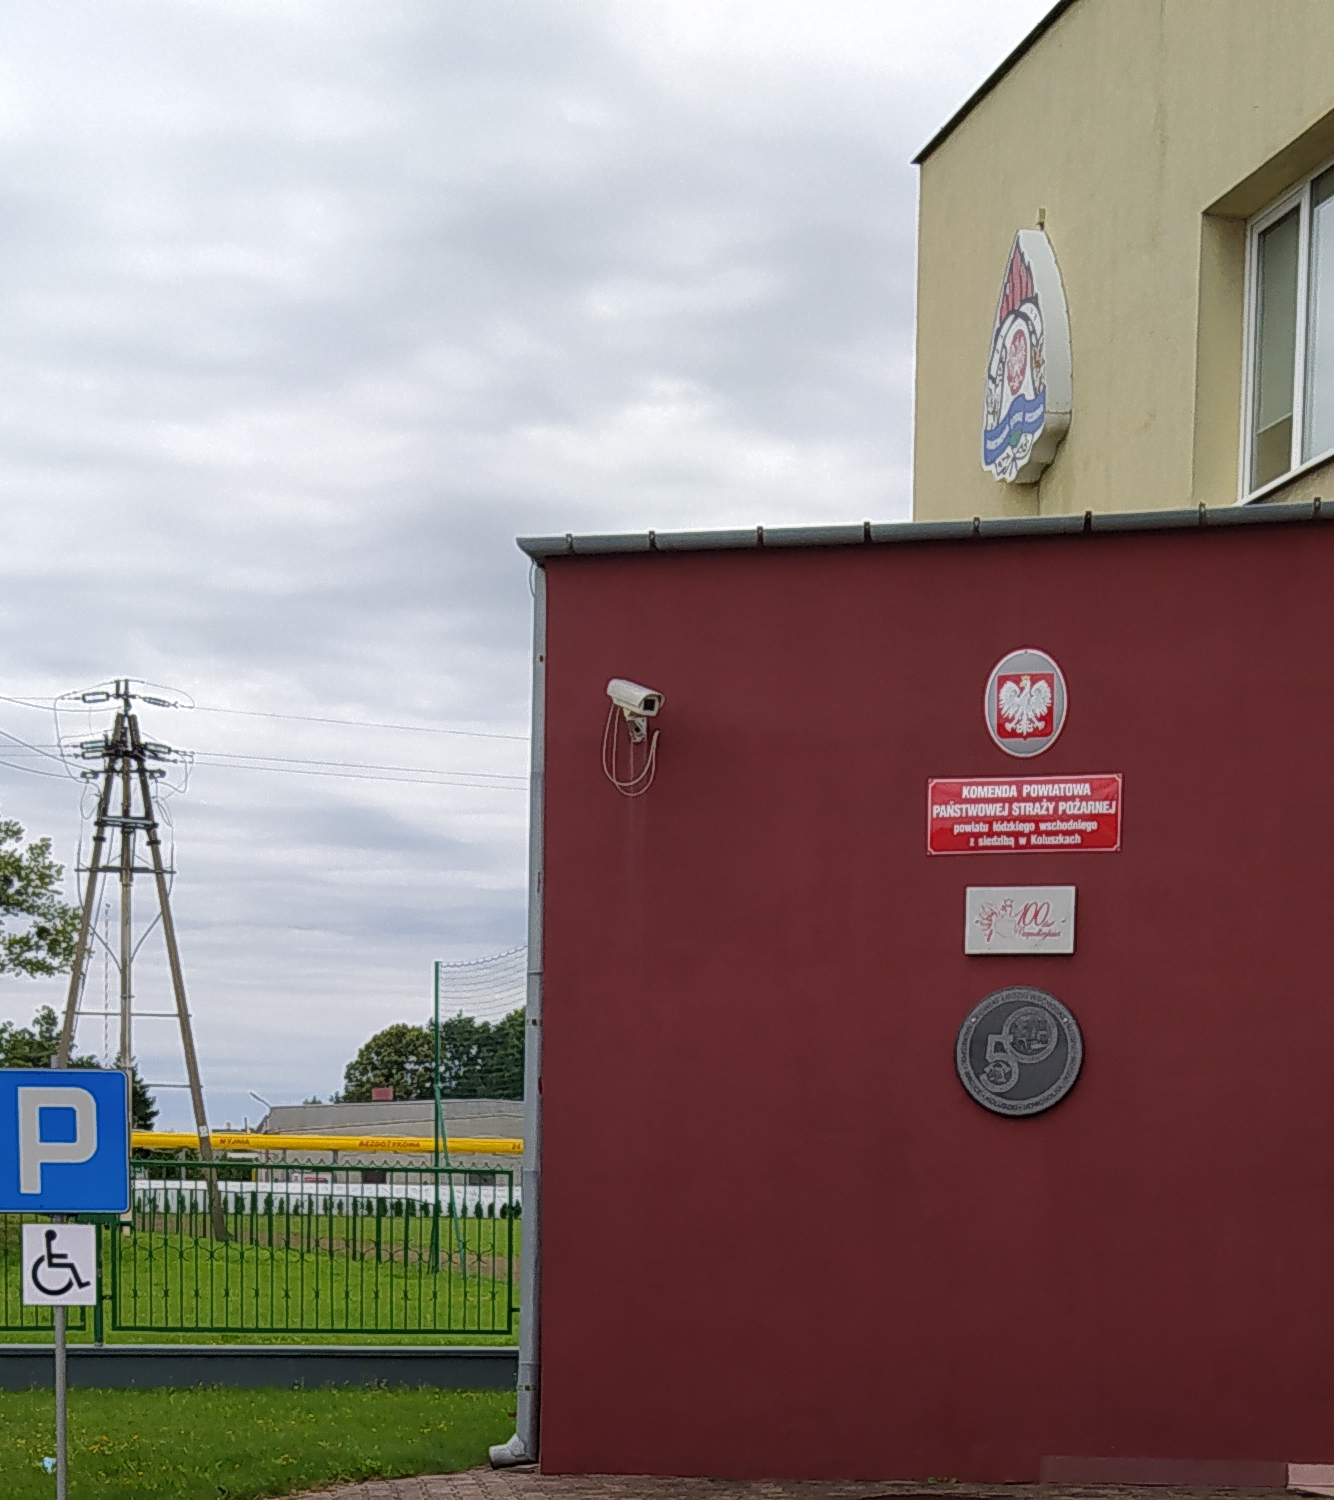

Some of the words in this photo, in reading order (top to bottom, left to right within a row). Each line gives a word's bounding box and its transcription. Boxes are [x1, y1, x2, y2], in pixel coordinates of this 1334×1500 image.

[962, 785, 1017, 798] KOMENDA
[1022, 783, 1091, 797] POWIATOWA
[933, 801, 1009, 818] PAŃSTWOWEJ
[1012, 799, 1055, 816] STRAŻY
[1058, 798, 1116, 815] POŻARNEJ
[953, 822, 989, 835] powiatu
[1039, 820, 1098, 833] wschodniego
[1019, 837, 1027, 846] w
[1030, 833, 1082, 845] Koluszkach
[1016, 901, 1051, 927] 100
[17, 1086, 98, 1195] P
